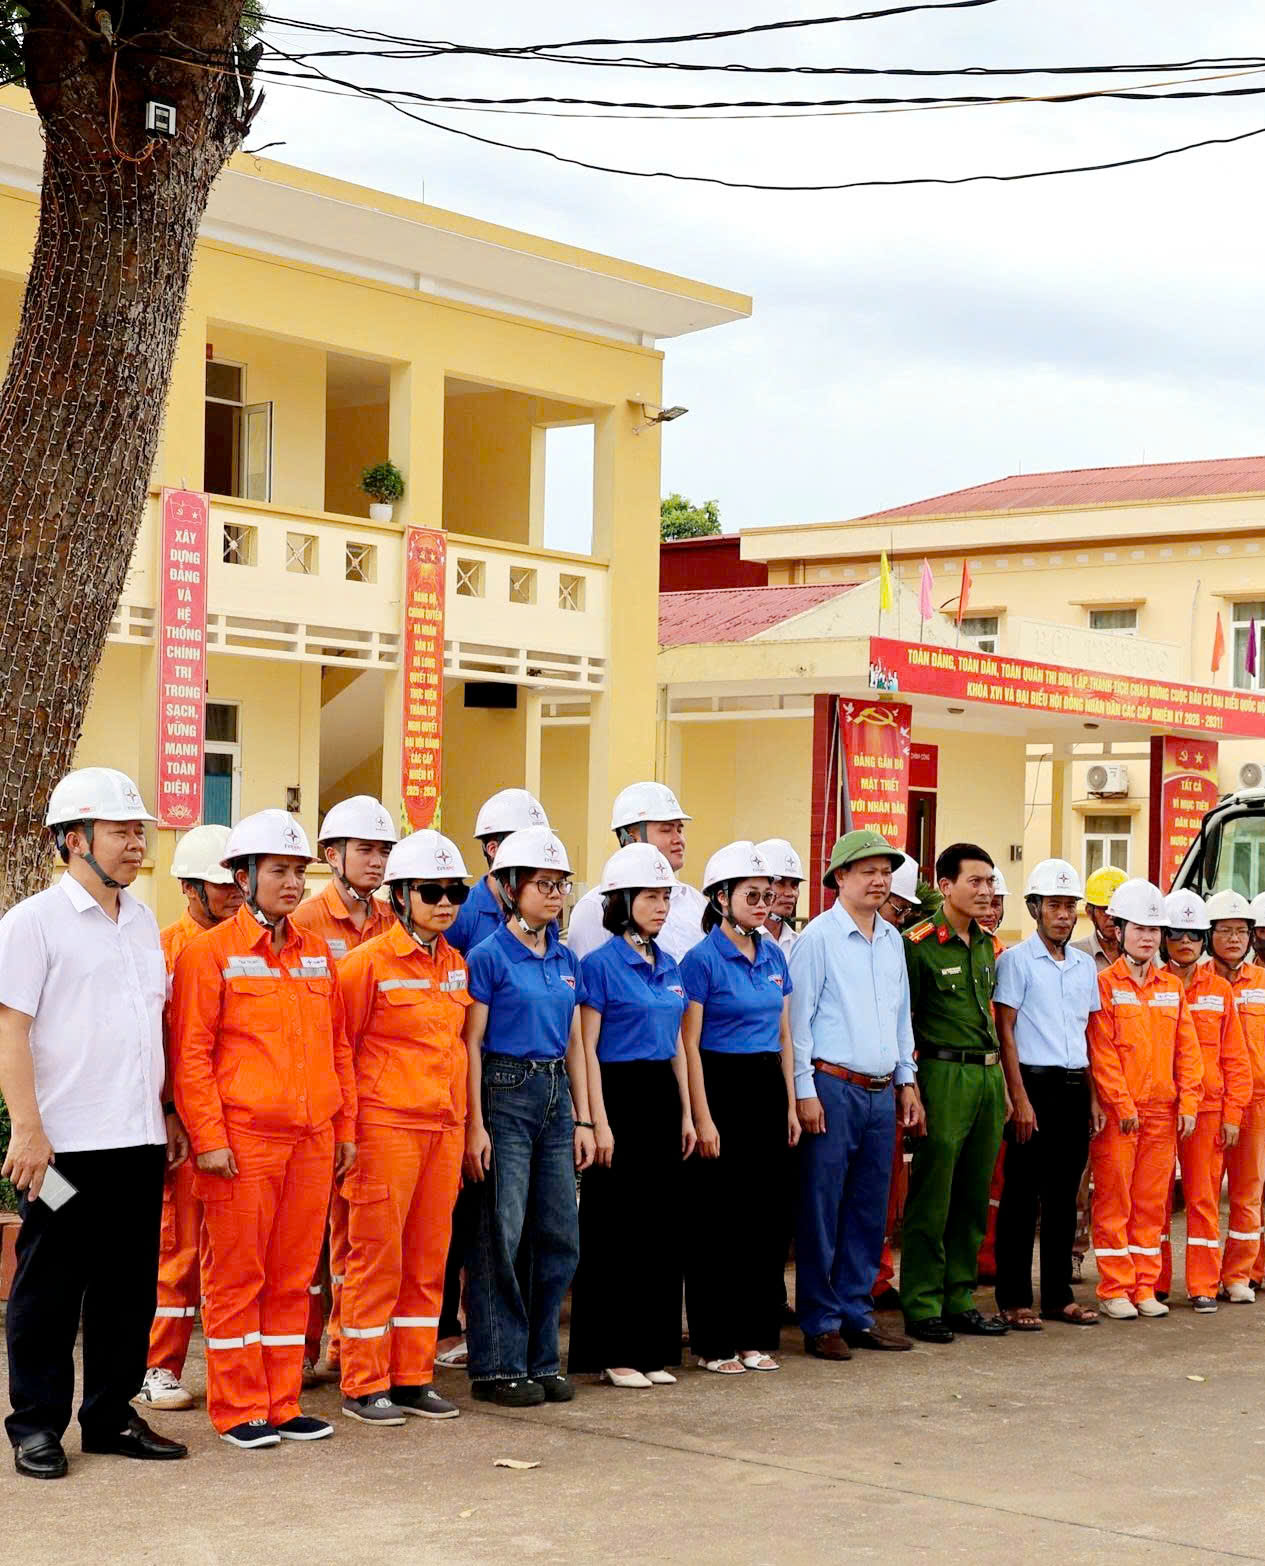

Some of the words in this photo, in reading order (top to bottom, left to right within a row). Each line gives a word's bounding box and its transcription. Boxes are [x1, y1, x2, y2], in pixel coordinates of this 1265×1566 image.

[175, 529, 197, 545] XÂY
[170, 549, 200, 568] DỰNG
[170, 564, 200, 584] ĐẢNG
[177, 586, 192, 602] VÀ
[177, 606, 192, 625] HỆ
[166, 623, 202, 642] THỐNG
[166, 644, 200, 661] CHÍNH
[174, 666, 192, 682] TRỊ
[908, 648, 930, 666] TOÀN
[931, 649, 956, 672] ĐẢNG,
[958, 656, 978, 674] TOÀN
[980, 658, 1000, 677] DÂN,
[1001, 662, 1022, 680] TOÀN
[1022, 664, 1044, 684] QUÂN
[1046, 669, 1056, 684] THI
[1058, 671, 1073, 688] ĐUA
[1089, 676, 1113, 694] THÀNH
[1114, 679, 1129, 696] TÍCH
[1130, 680, 1148, 698] CHÀO
[1150, 684, 1170, 701] MỪNG
[1171, 687, 1188, 706] CUỘC
[1189, 688, 1202, 706] BẦU
[1213, 694, 1224, 711] ĐẠI
[1224, 694, 1239, 710] BIỂU
[1240, 696, 1256, 712] QUỐC
[165, 684, 200, 699] TRONG
[966, 680, 988, 698] KHÓA
[990, 686, 1002, 700] XVI
[1004, 686, 1014, 702] VÀ
[1016, 690, 1030, 708] ĐẠI
[1031, 688, 1048, 708] BIỂU
[1050, 692, 1062, 711] HỘI
[1064, 694, 1084, 712] ĐỒNG
[1085, 696, 1105, 714] NHÂN
[1106, 700, 1121, 716] DÂN
[1122, 702, 1136, 718] CÁC
[1136, 703, 1150, 720] CẤP
[1152, 706, 1174, 725] NHIỆM
[1184, 712, 1200, 726] 2026
[166, 704, 199, 720] SẠCH,
[167, 720, 197, 737] VỮNG
[164, 742, 198, 758] MẠNH
[166, 760, 196, 776] TOÀN
[854, 753, 876, 769] ĐẢNG
[878, 754, 892, 770] GẮN
[164, 780, 190, 796] DIỆN
[860, 776, 877, 793] MẬT
[880, 777, 899, 792] THIẾT
[1181, 778, 1192, 792] TẤT
[1192, 779, 1202, 793] CẢ
[850, 798, 865, 812] VỚI
[868, 800, 890, 814] NHÂN
[891, 800, 907, 816] DÂN,
[1172, 796, 1180, 808] VÌ
[1180, 798, 1194, 812] MỤC
[882, 822, 898, 836] VÀO
[1174, 816, 1188, 828] DÂN
